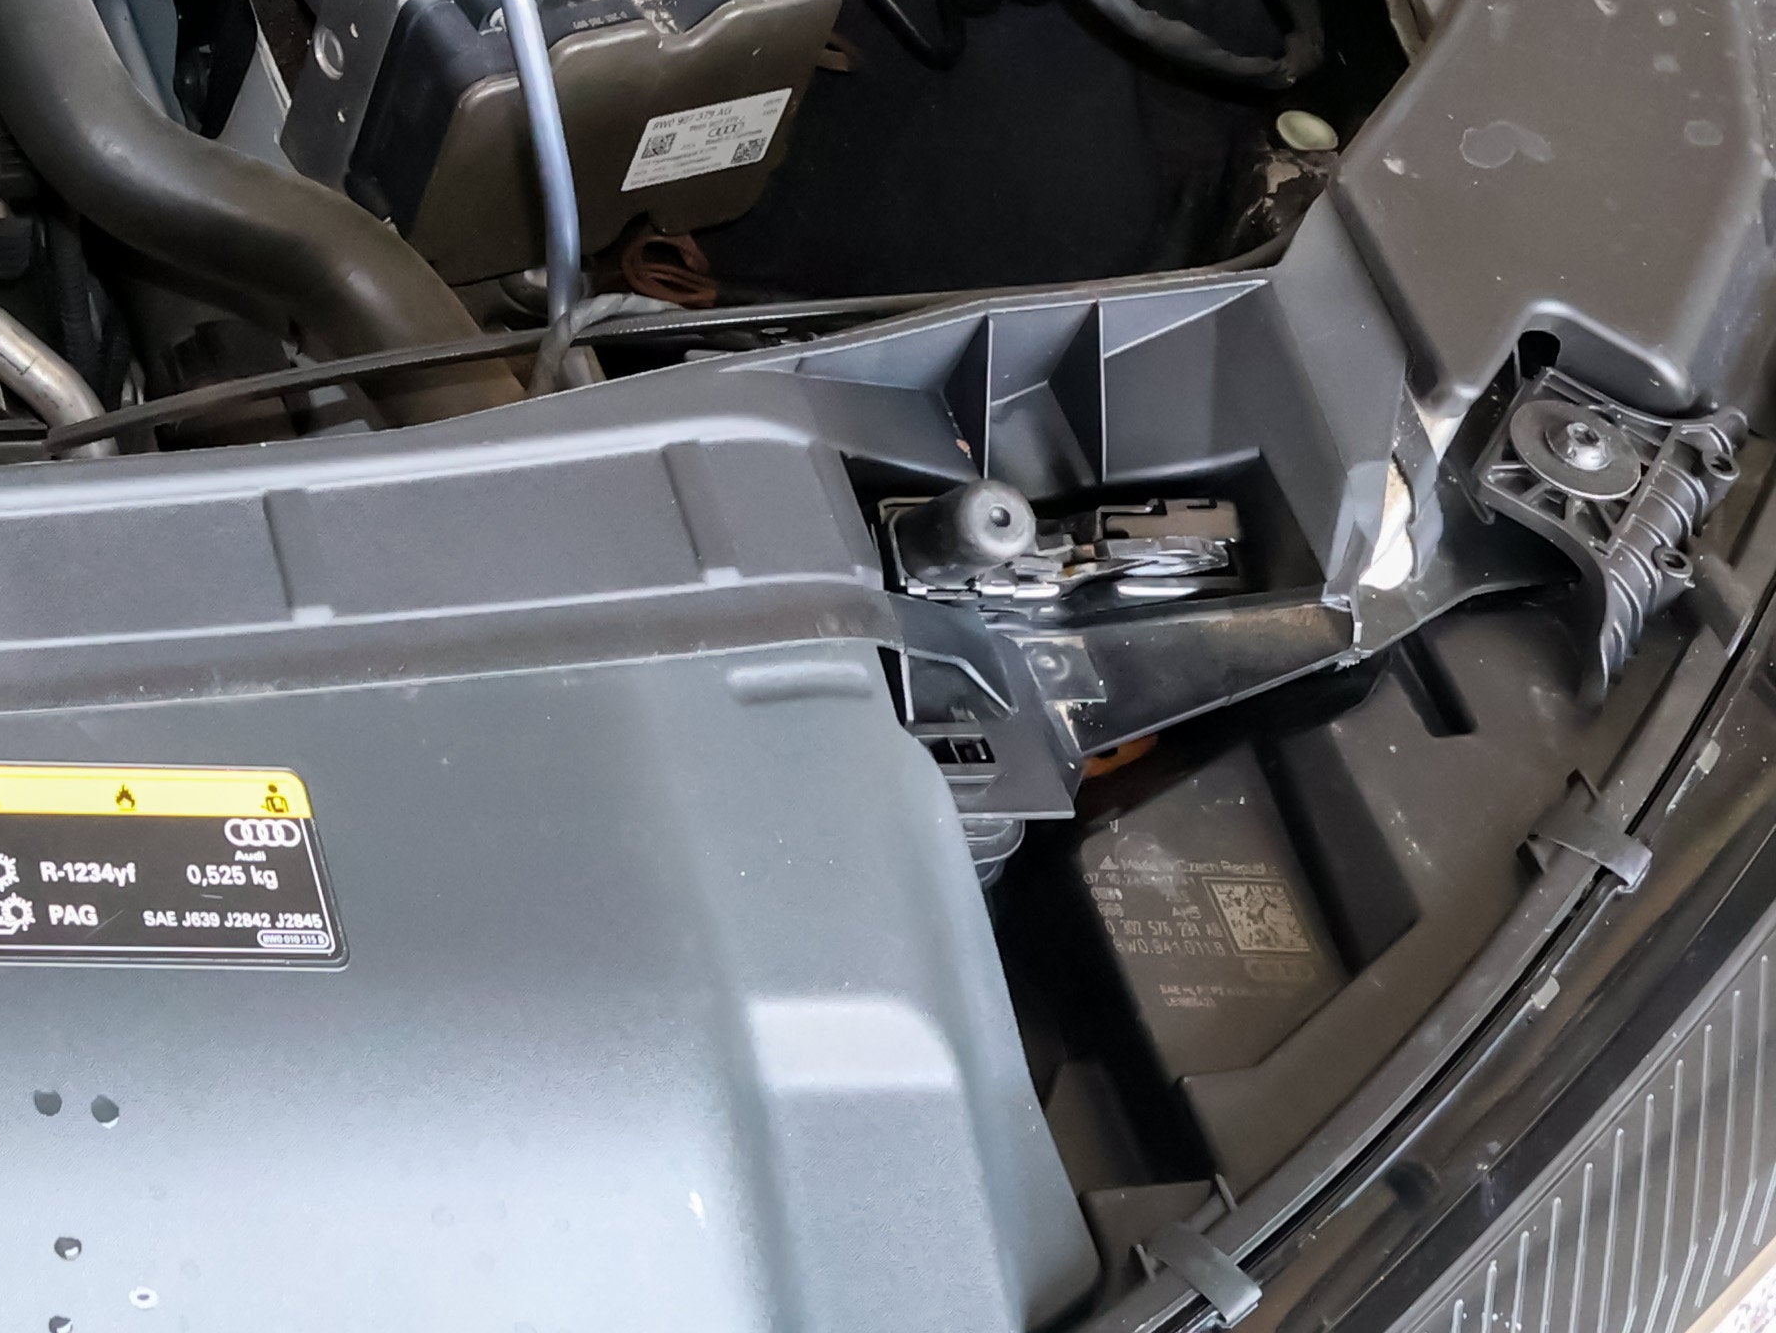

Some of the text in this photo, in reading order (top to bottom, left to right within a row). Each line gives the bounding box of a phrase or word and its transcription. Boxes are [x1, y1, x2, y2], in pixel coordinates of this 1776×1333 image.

[234, 850, 266, 862] Audi
[40, 860, 278, 889] R-1234yf 0,525 kg
[48, 904, 323, 929] PAG SAE J639 J2842 J2845
